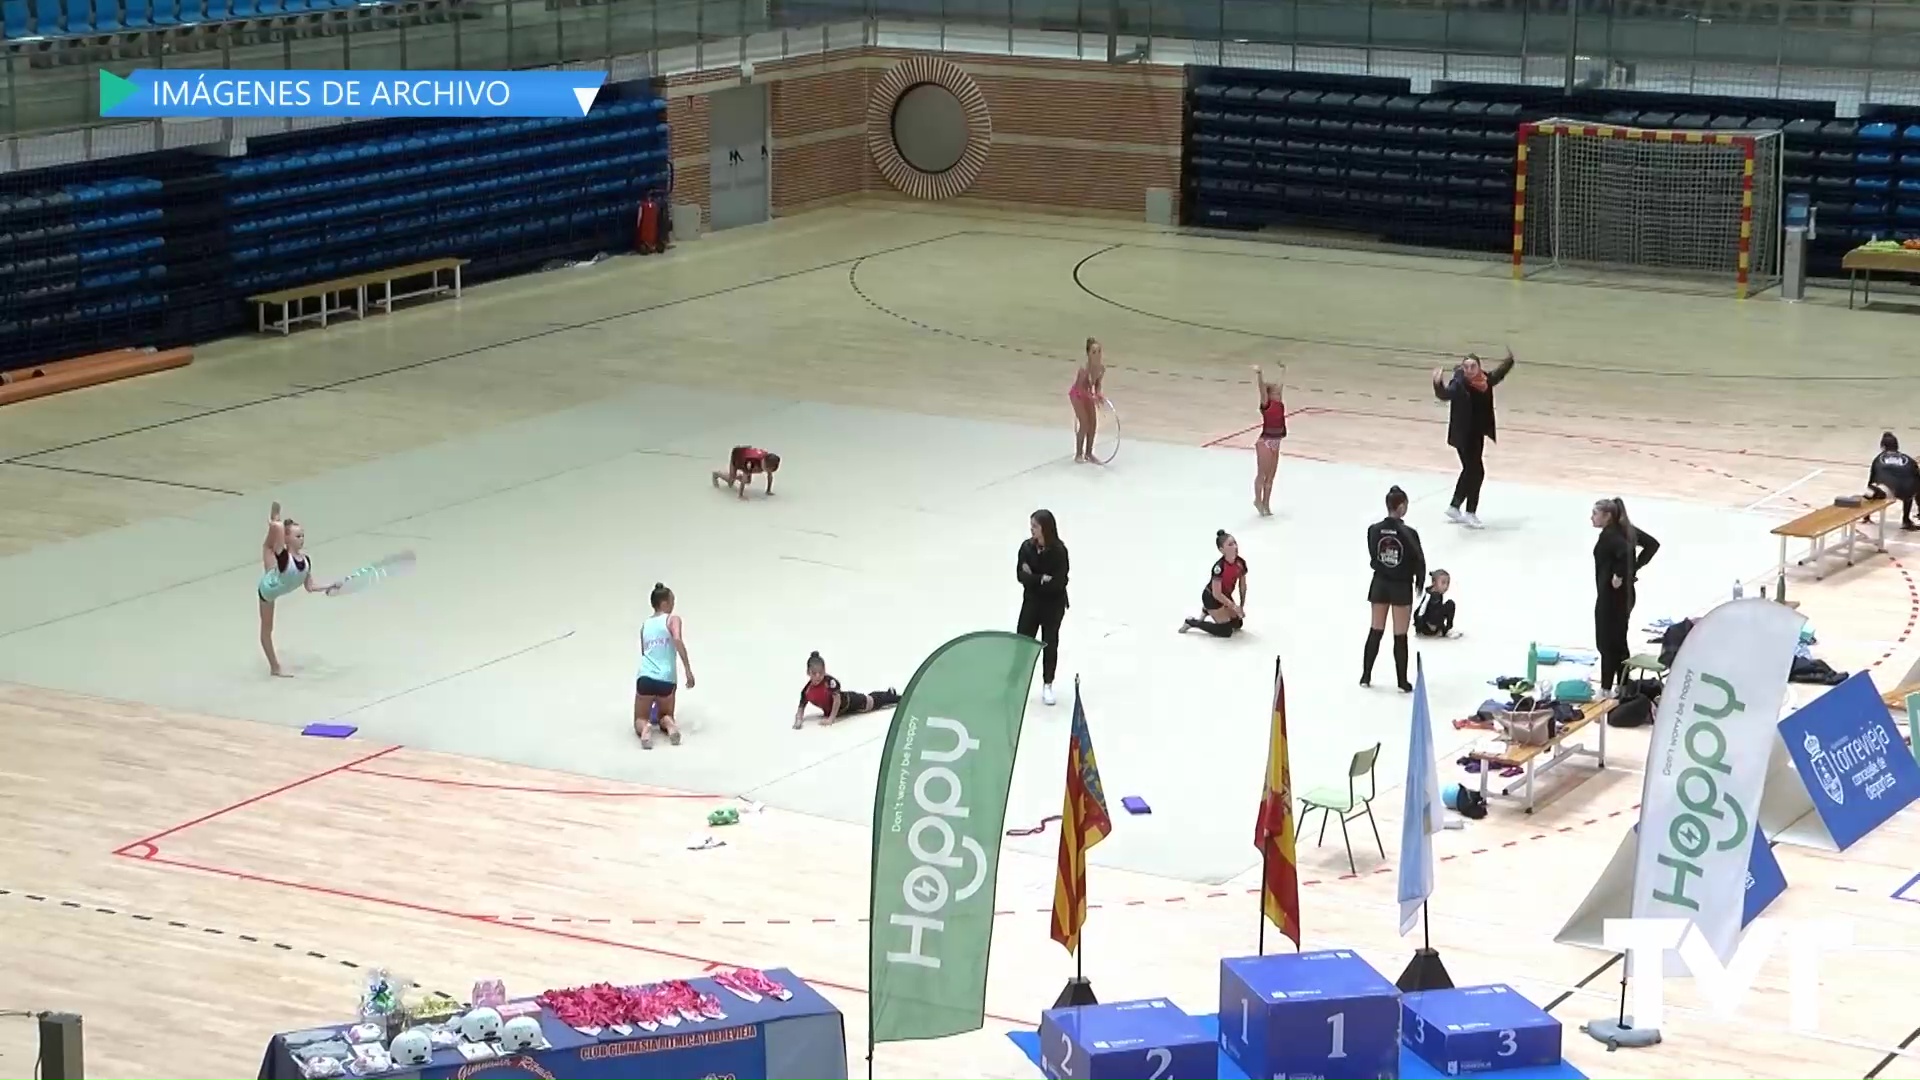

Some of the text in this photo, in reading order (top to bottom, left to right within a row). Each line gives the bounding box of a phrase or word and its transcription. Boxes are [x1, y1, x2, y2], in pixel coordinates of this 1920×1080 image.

[1676, 702, 1685, 716] be
[1829, 720, 1890, 774] torrevieja
[892, 715, 919, 832] Don't worry be hoppy
[1653, 672, 1746, 911] Hoppy
[886, 716, 980, 969] Hoppy
[580, 1047, 608, 1061] CLUB
[608, 1039, 657, 1057] GIMNASIA
[700, 1025, 757, 1046] TORREVIEJA
[1241, 998, 1249, 1045] 1
[1327, 1012, 1347, 1058] 1
[1414, 1014, 1425, 1044] 3
[1496, 1028, 1518, 1056] 3
[1061, 1032, 1073, 1076] 2
[1146, 1048, 1174, 1080] 2
